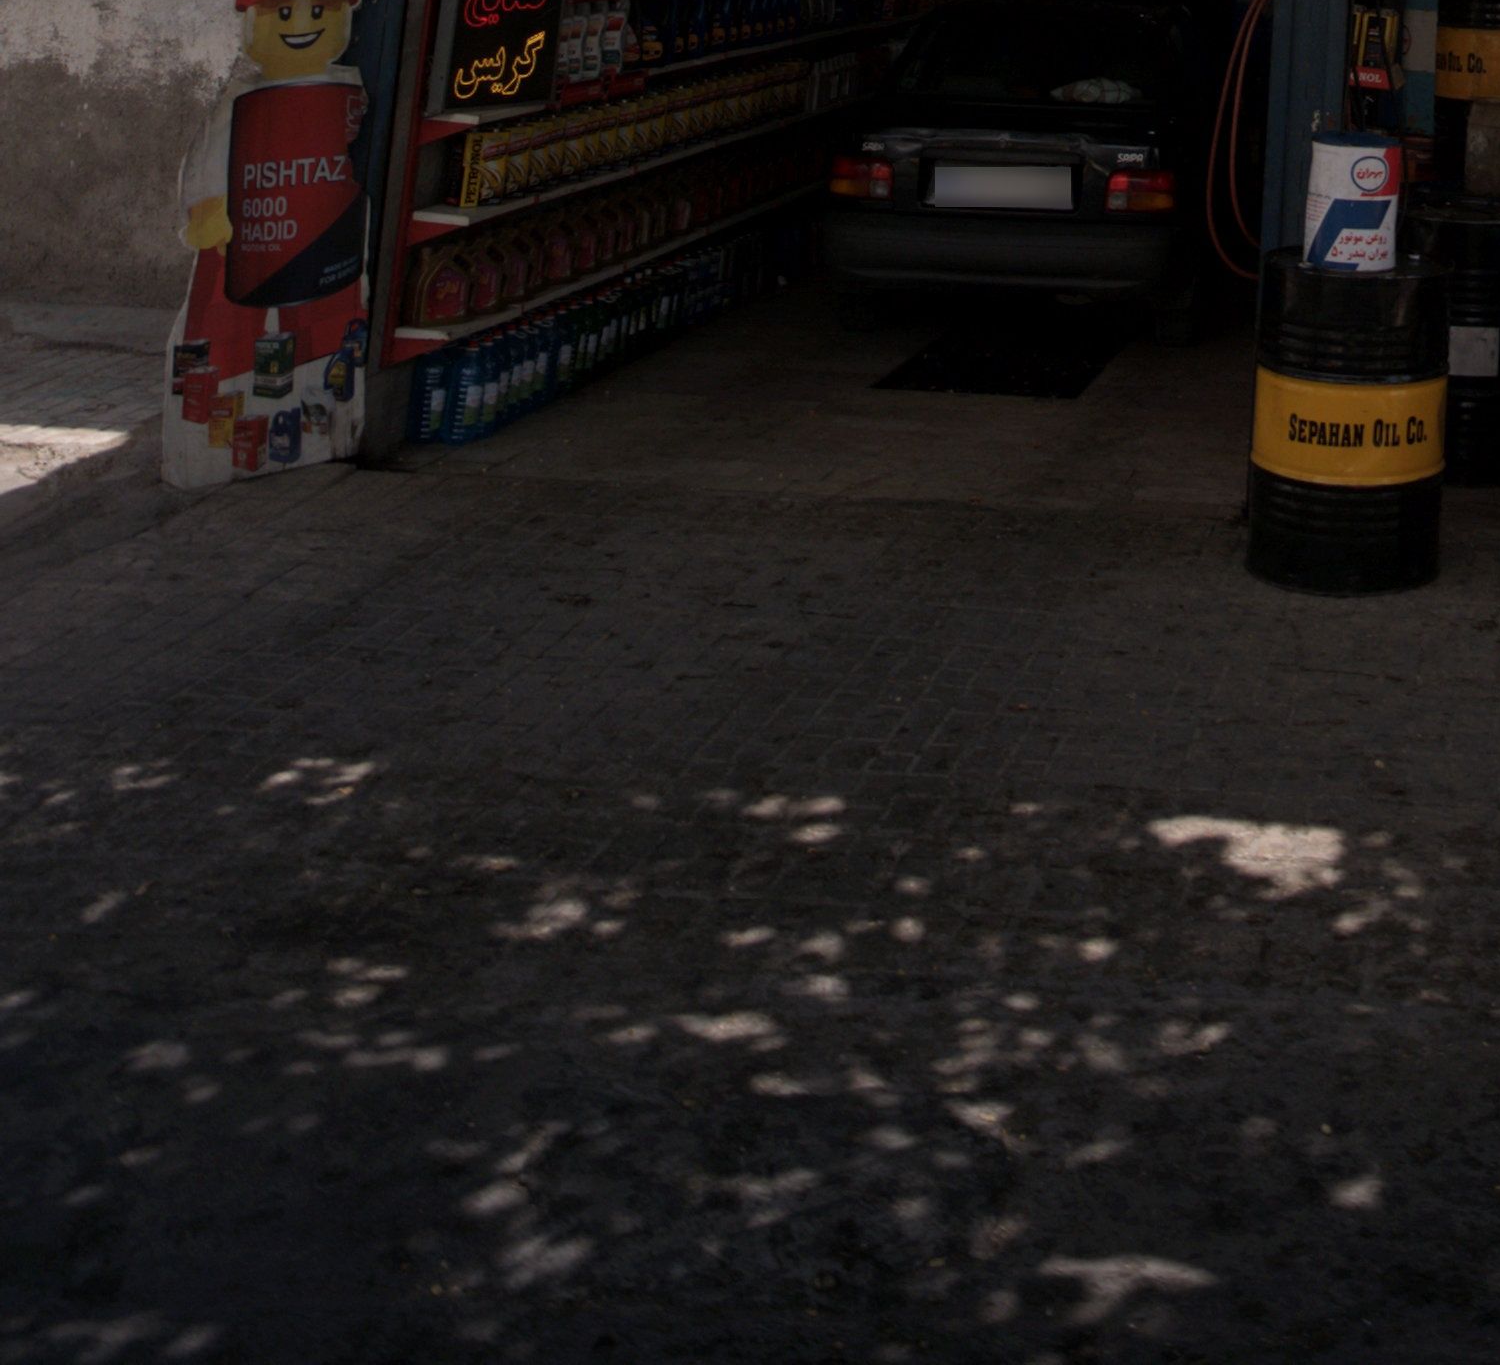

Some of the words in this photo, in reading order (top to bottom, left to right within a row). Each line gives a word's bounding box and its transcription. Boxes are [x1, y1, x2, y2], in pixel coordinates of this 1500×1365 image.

[454, 30, 547, 99] گریس
[243, 155, 347, 190] PISHTAZ
[241, 196, 288, 218] 6000
[240, 219, 298, 242] HADID
